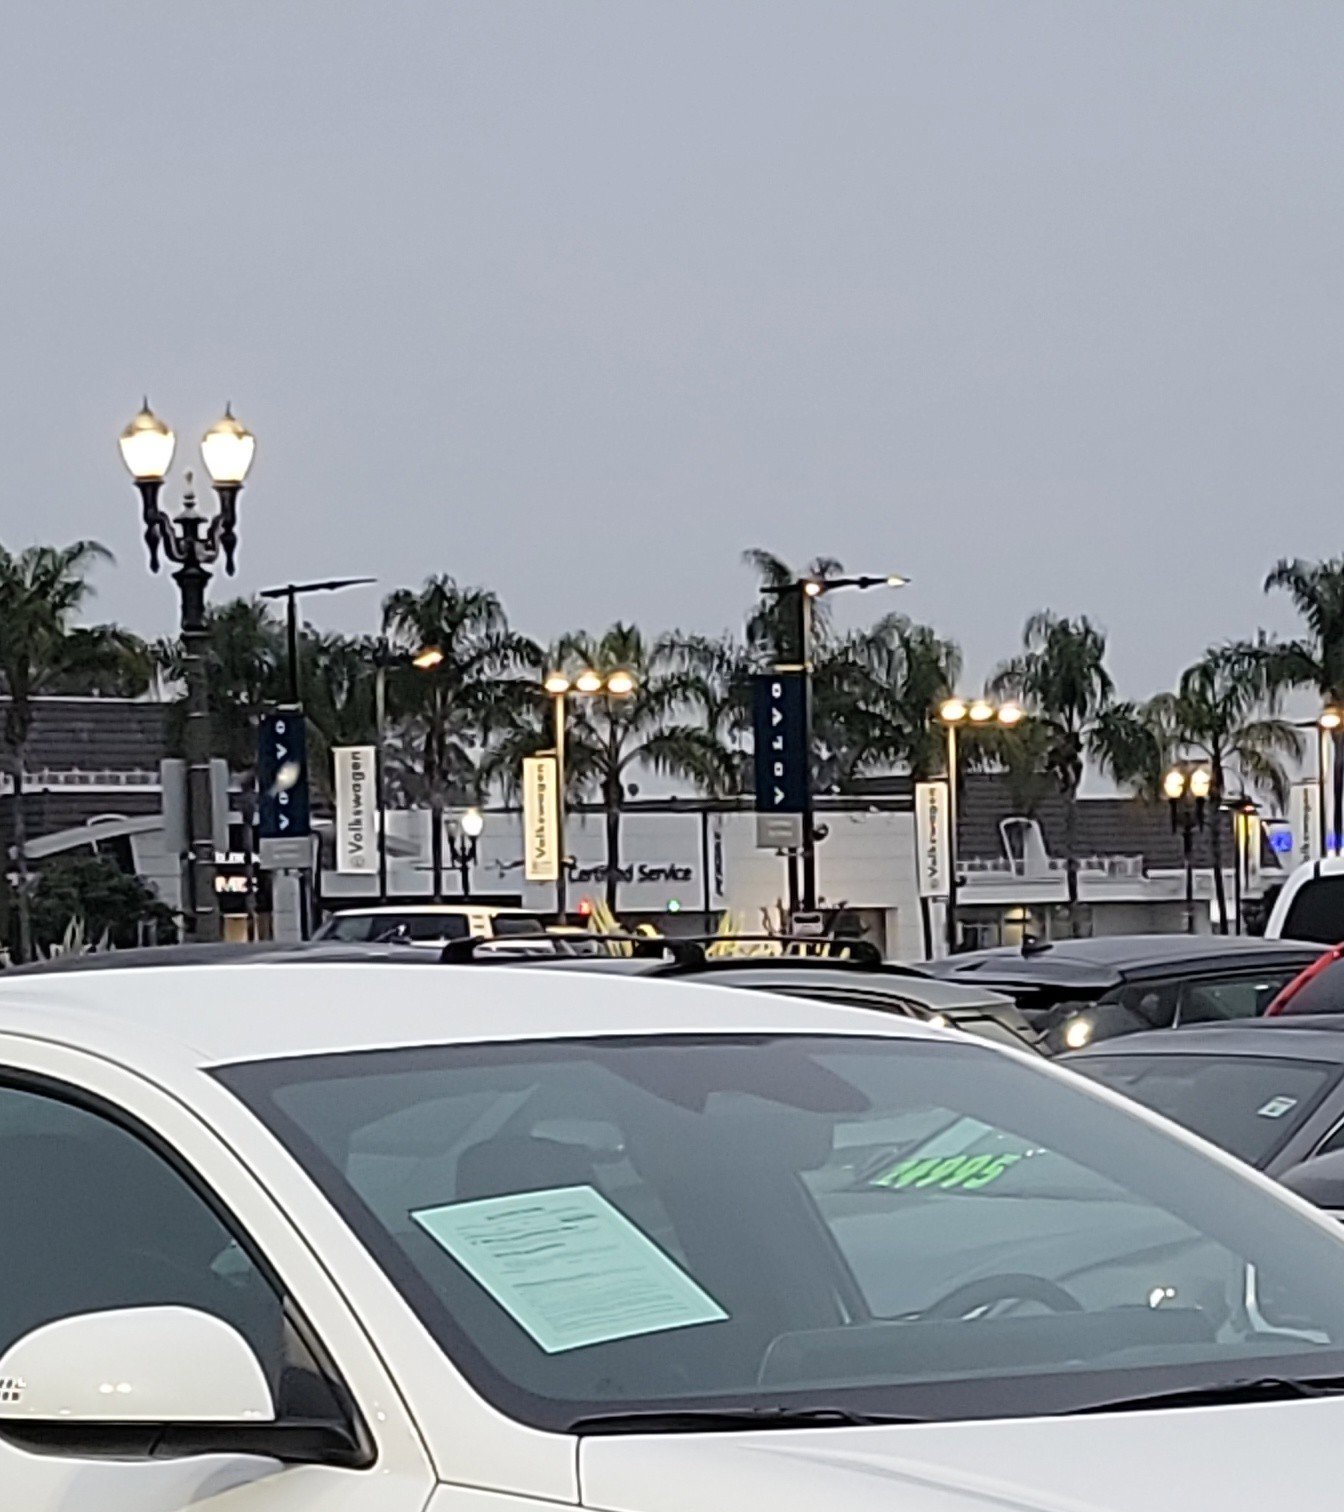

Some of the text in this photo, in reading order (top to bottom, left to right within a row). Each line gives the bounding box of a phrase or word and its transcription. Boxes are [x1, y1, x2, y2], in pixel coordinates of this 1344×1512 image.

[274, 719, 290, 831] VOVO
[771, 682, 785, 805] VOLVO
[348, 751, 366, 854] Volkswagen
[534, 763, 547, 859] Volkswagen
[568, 863, 693, 883] Certed Service
